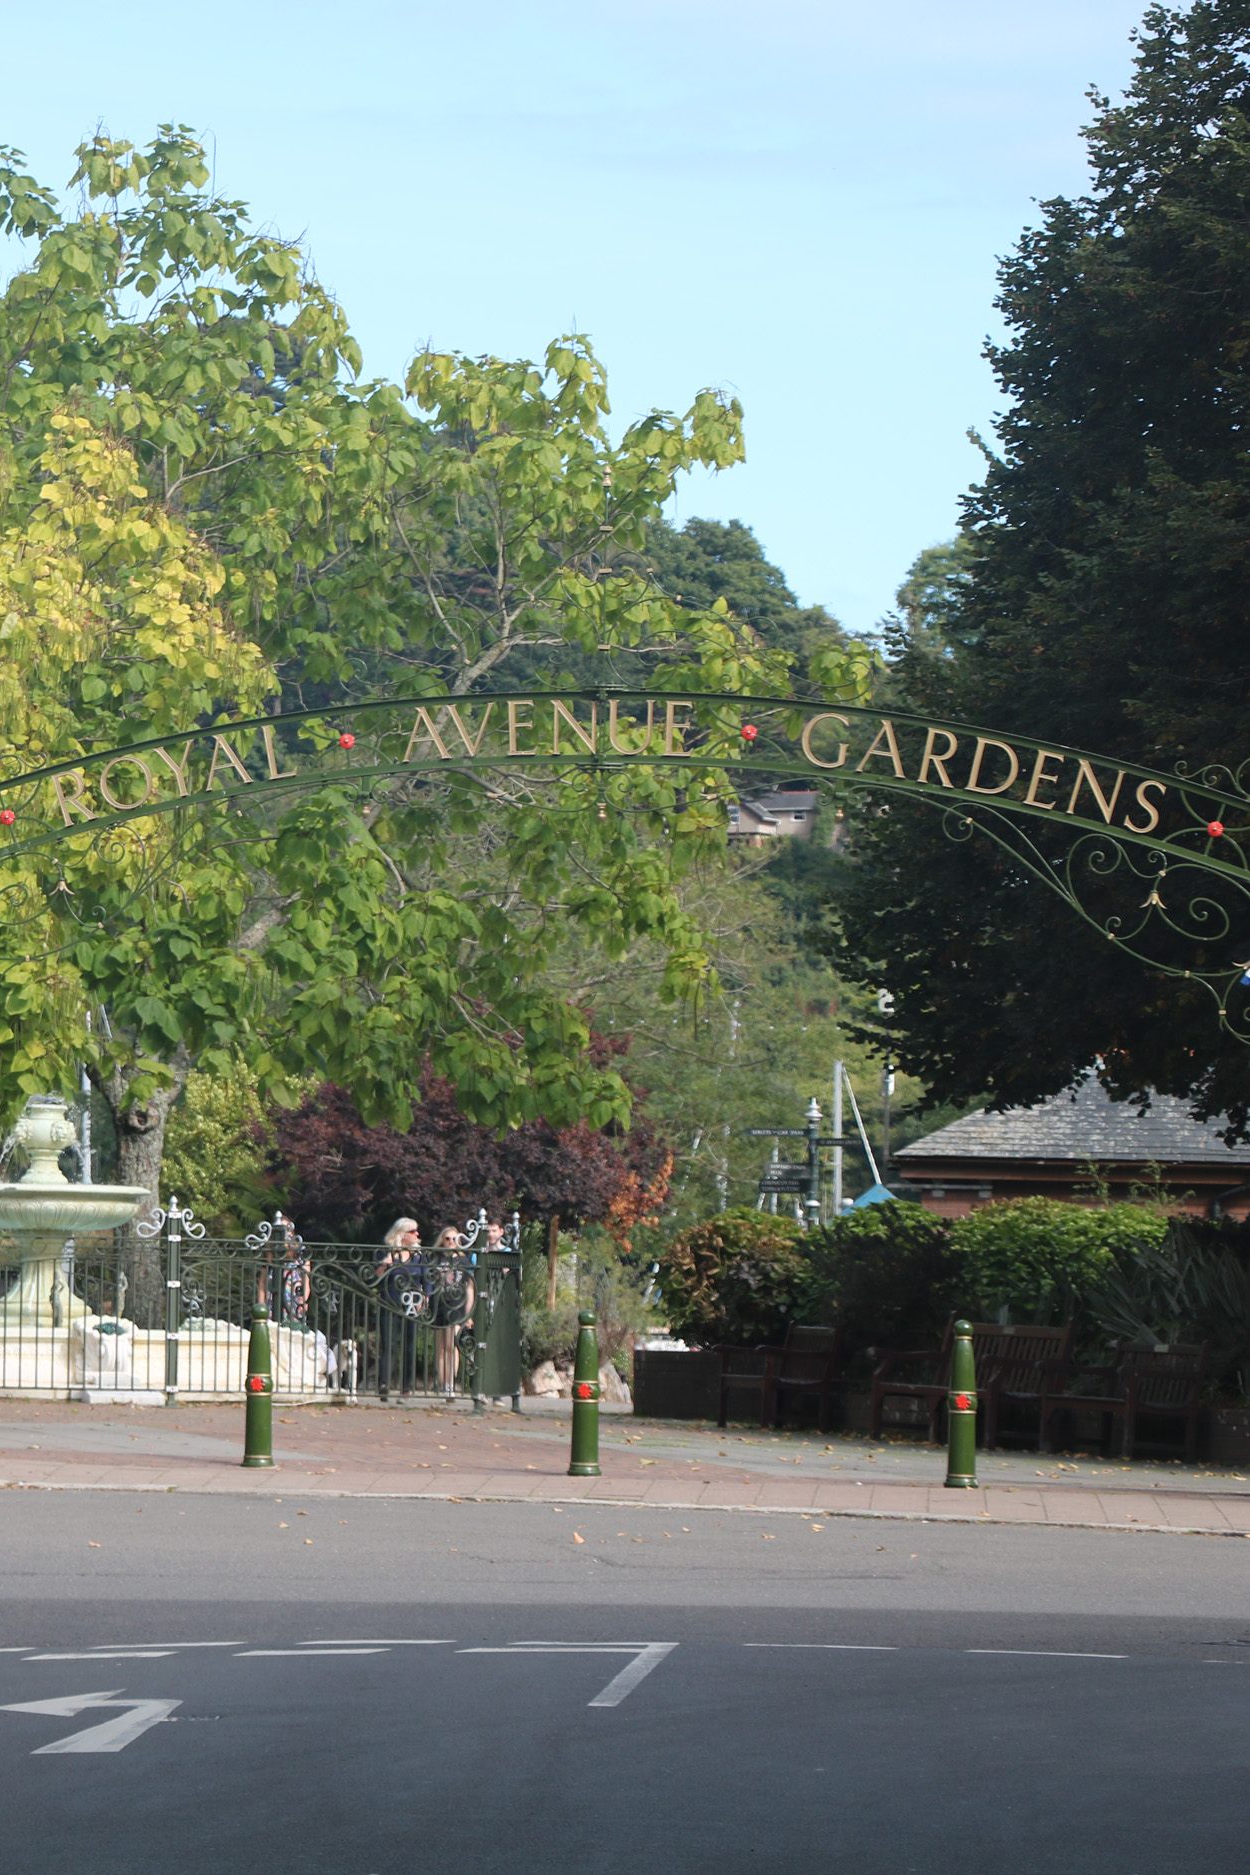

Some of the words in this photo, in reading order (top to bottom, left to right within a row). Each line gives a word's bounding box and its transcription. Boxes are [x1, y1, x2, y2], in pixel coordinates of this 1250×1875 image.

[51, 724, 299, 827] ROYAL
[403, 699, 694, 763] AVENUE
[801, 712, 1168, 834] GARDENS
